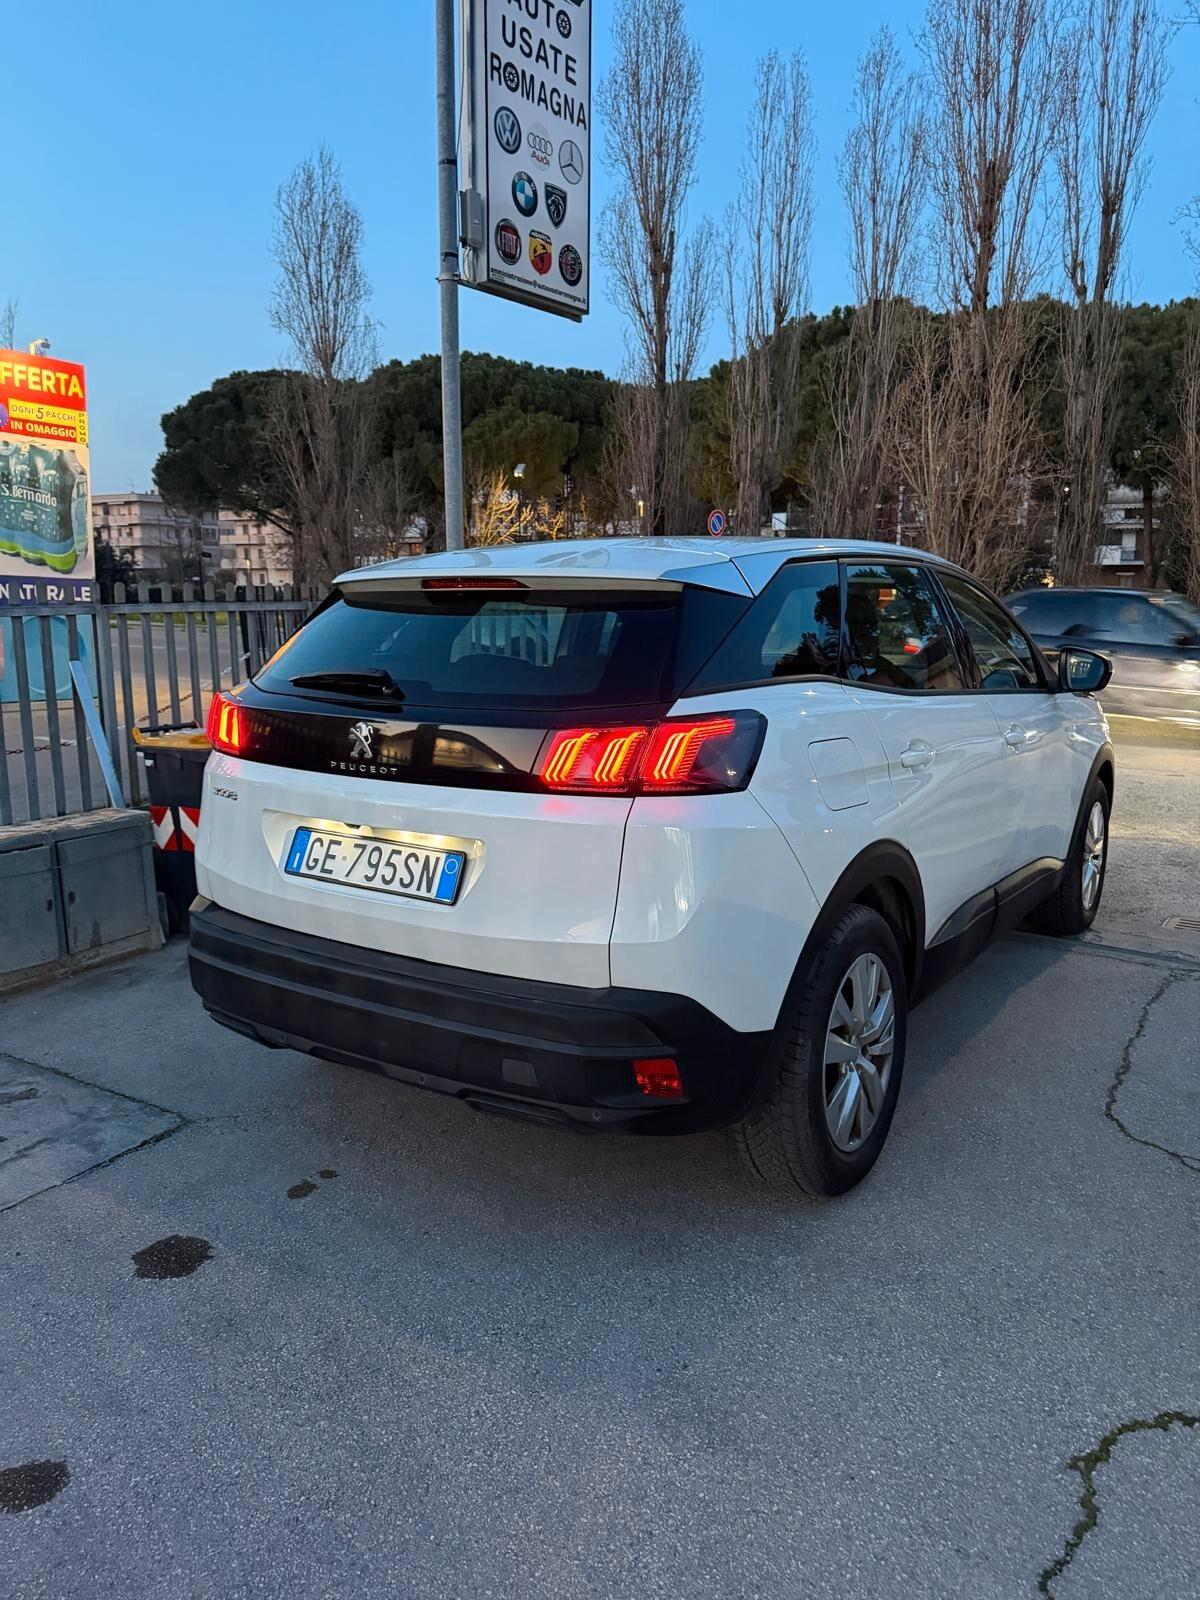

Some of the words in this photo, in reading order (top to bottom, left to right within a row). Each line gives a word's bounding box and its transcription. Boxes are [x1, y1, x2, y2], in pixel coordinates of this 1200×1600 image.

[508, 0, 572, 39] UTO
[502, 14, 577, 86] USATE
[490, 51, 587, 131] ROMAGNA
[531, 150, 550, 166] Audi
[11, 404, 34, 414] OGNI
[36, 407, 44, 420] 5
[46, 411, 76, 422] PACCHI
[10, 420, 23, 431] IN
[25, 422, 77, 439] OMAGGIO
[1, 483, 57, 507] S.Bernardo
[330, 760, 399, 776] PEUGEOT
[305, 836, 343, 875] GE
[344, 843, 441, 894] 795SN
